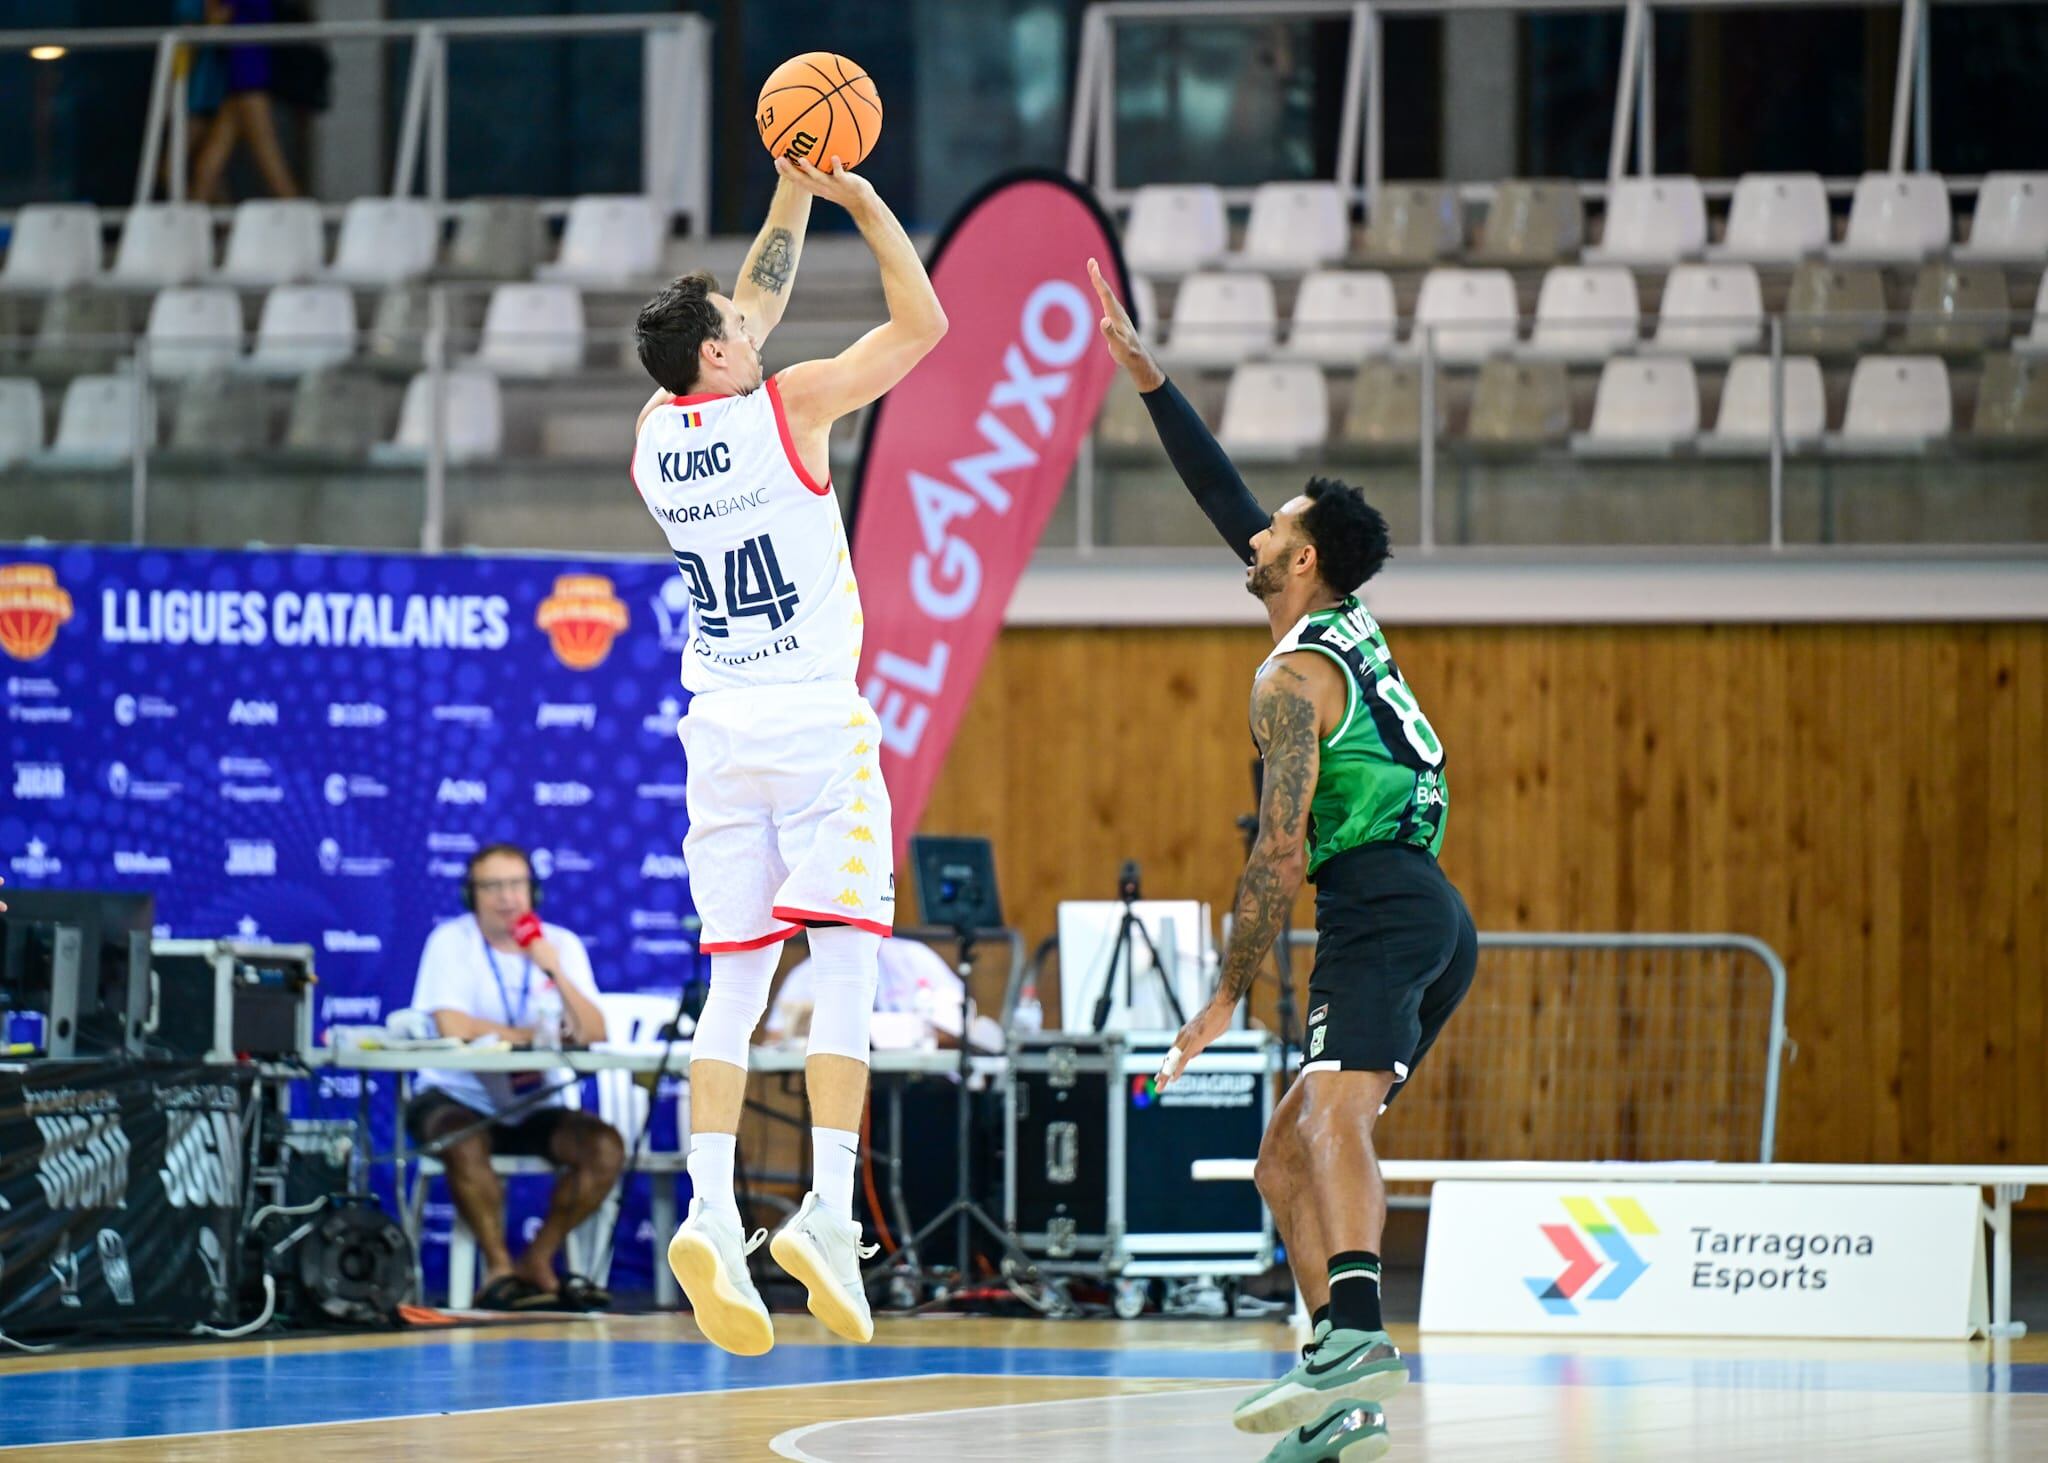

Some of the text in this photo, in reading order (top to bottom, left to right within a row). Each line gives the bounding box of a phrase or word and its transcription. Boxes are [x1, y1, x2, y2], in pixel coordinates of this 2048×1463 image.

[657, 442, 731, 483] KURIC
[662, 487, 770, 524] MORABANC
[864, 279, 1094, 759] EL GANXO
[673, 533, 801, 638] 24
[102, 588, 267, 645] LLIGUES
[272, 591, 510, 650] CATALANES
[1691, 1226, 1874, 1260] Tarragona
[1691, 1262, 1829, 1295] Esports
